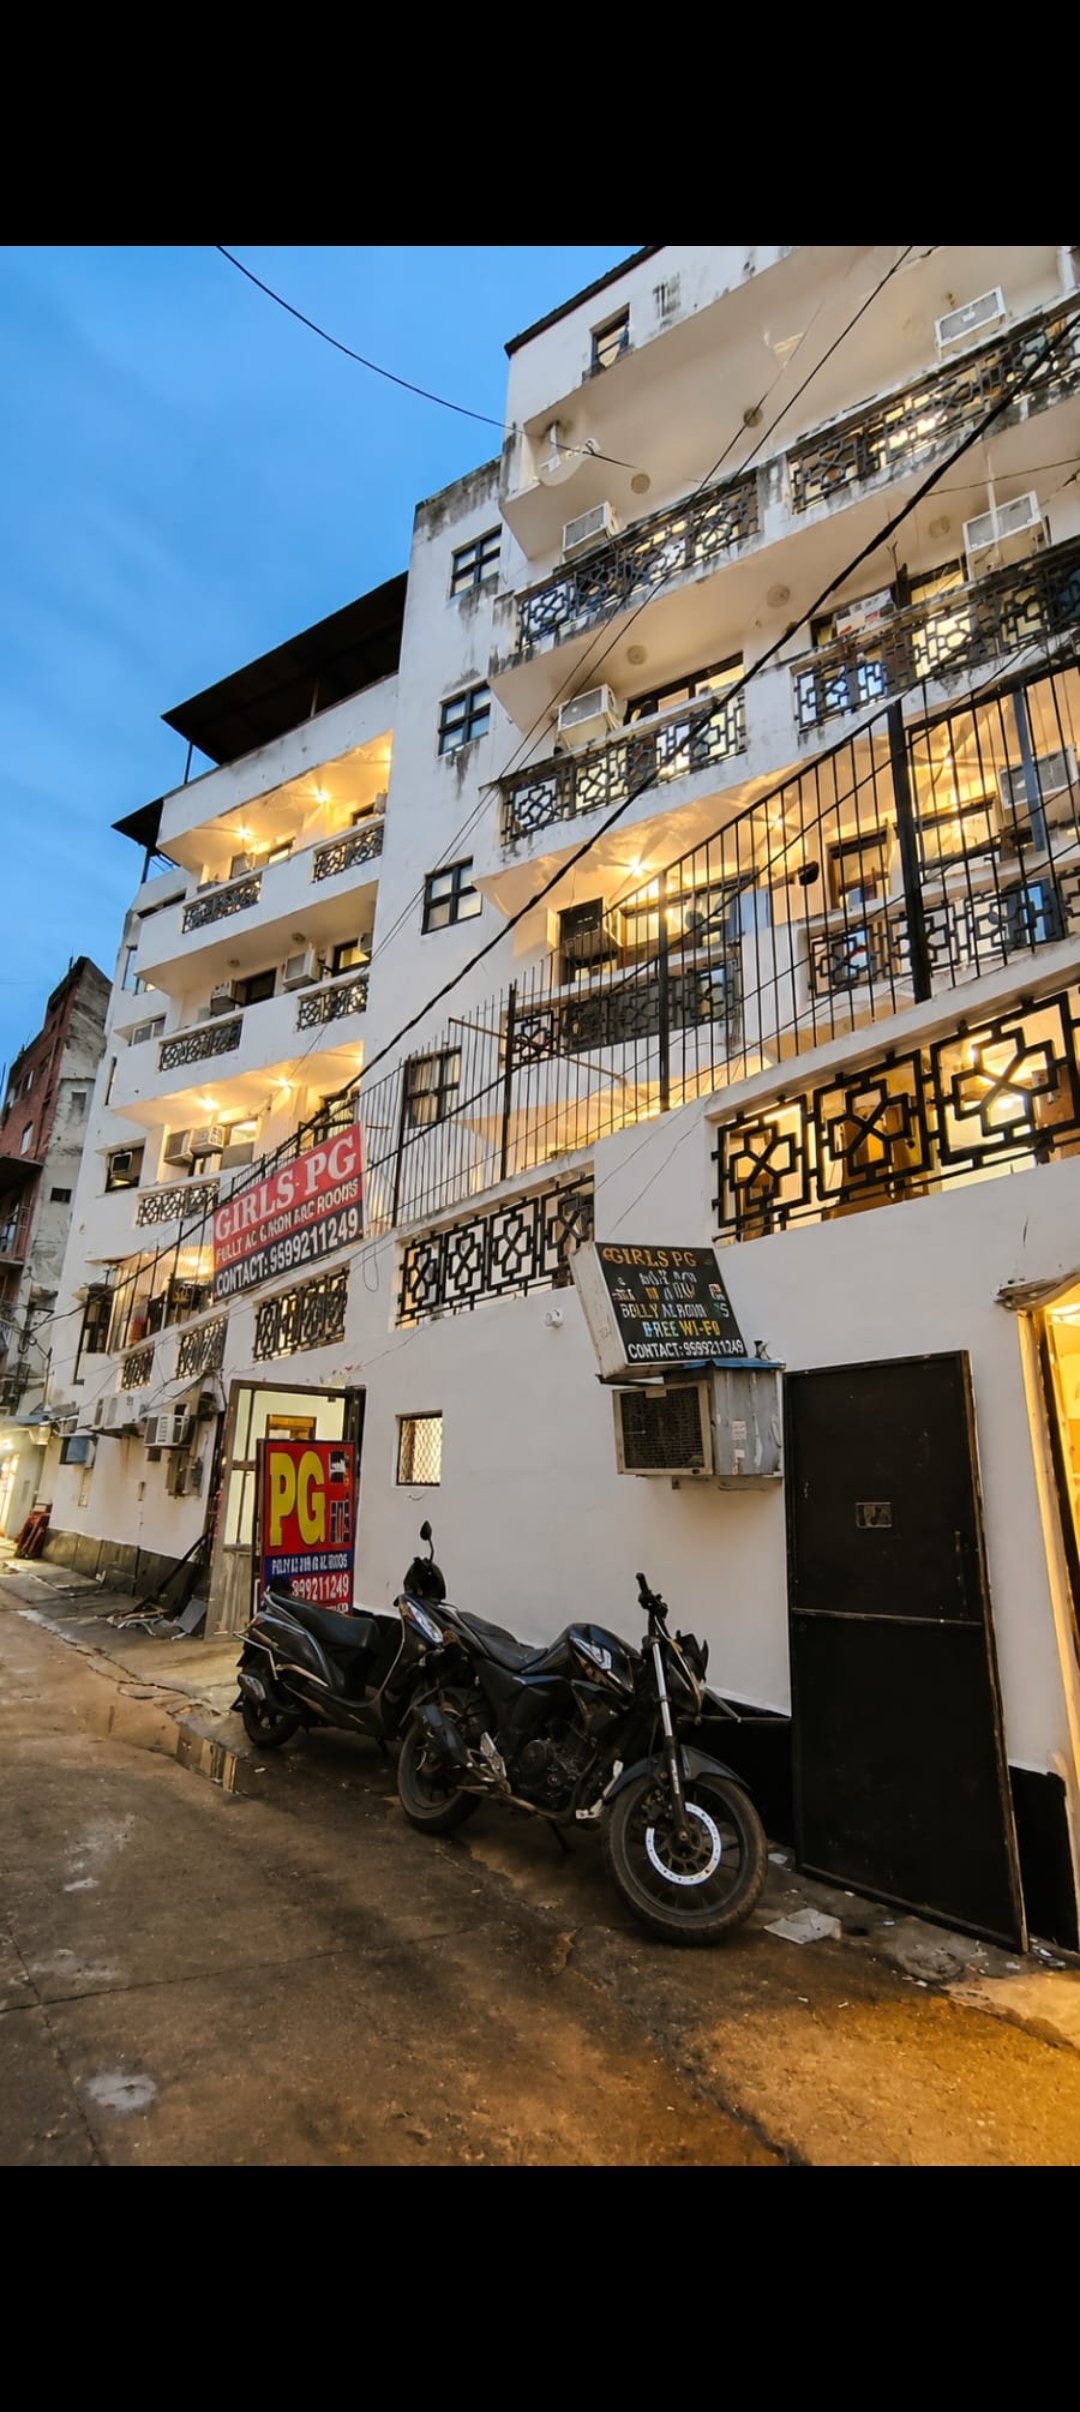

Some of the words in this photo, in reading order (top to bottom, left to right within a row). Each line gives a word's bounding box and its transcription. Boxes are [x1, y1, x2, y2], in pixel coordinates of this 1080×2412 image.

[215, 1171, 295, 1241] GIRLS
[304, 1135, 357, 1195] PG
[672, 1251, 697, 1267] PG
[269, 1450, 326, 1546] PG
